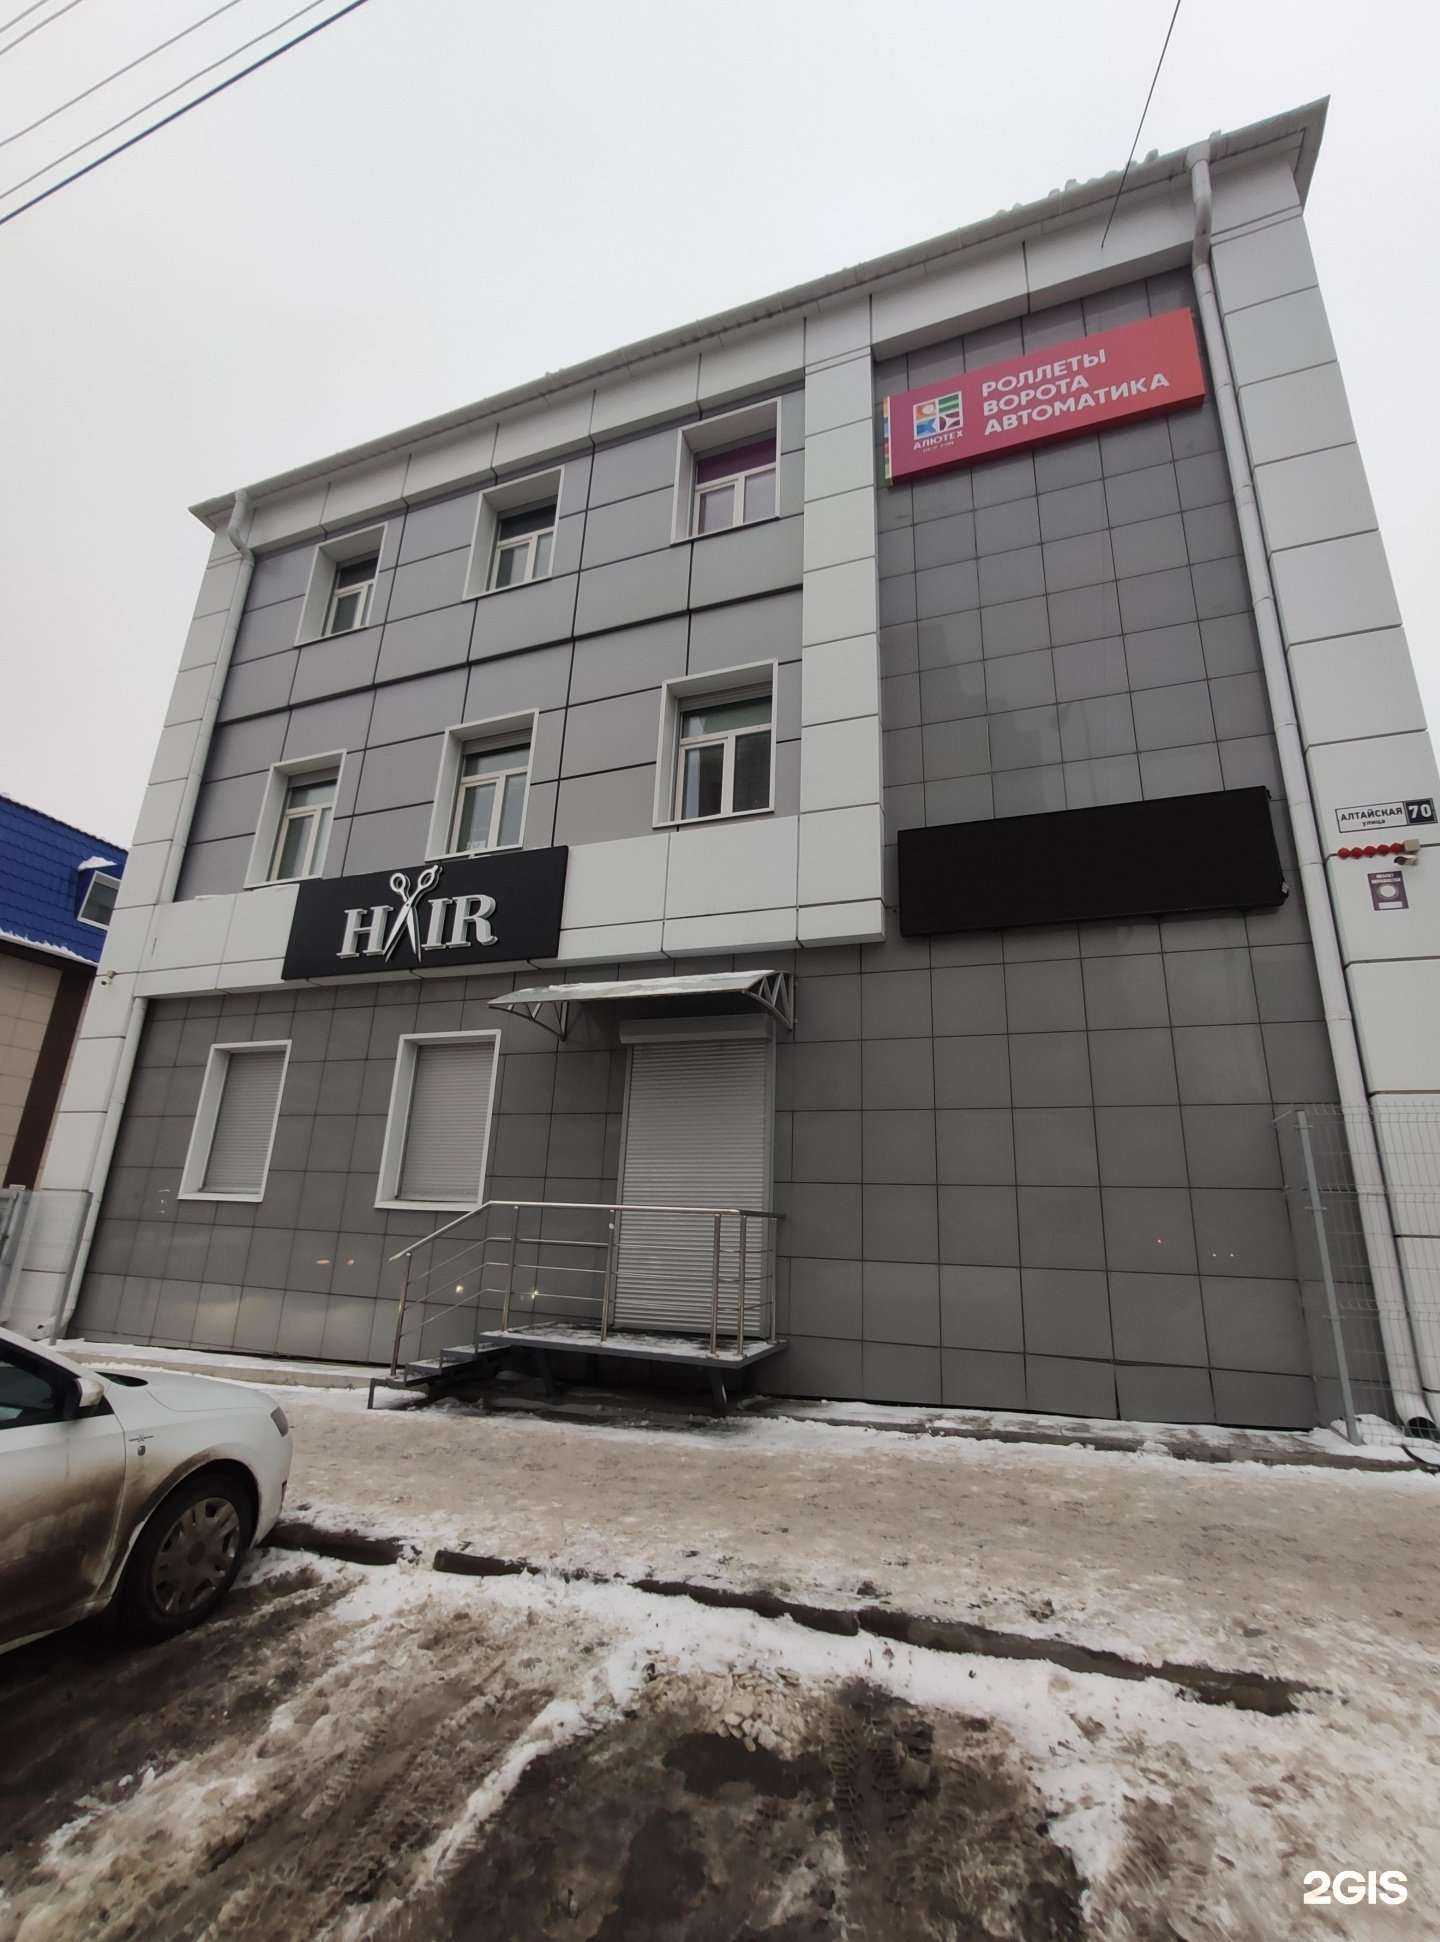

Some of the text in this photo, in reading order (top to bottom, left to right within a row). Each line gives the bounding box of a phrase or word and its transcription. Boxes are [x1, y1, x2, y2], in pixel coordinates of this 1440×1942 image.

[982, 349, 1106, 397] РОЛЛЕТЫ
[983, 375, 1089, 417] ВОРОТА
[984, 373, 1170, 435] АВТОМАТИКА
[913, 430, 964, 450] АЛЮТЕХ
[1341, 804, 1432, 821] АЛТАЙСКАЯ 70
